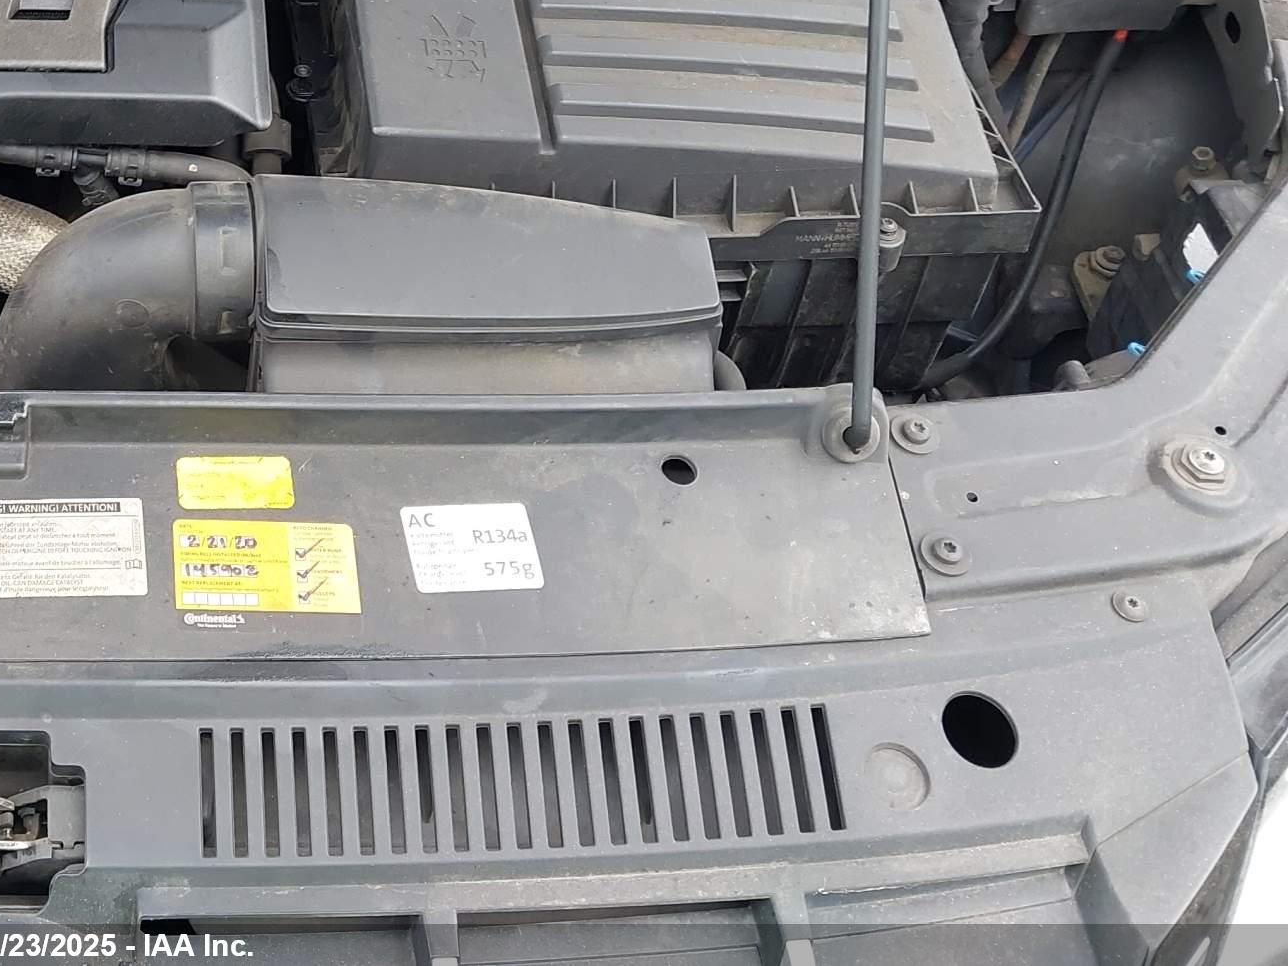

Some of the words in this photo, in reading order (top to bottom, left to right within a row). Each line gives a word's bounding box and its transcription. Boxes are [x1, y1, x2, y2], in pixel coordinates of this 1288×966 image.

[8, 504, 59, 514] WARNING!
[61, 503, 118, 513] ATTENTION!
[408, 512, 436, 528] AC
[472, 529, 528, 544] R134a
[484, 561, 535, 579] 575g
[183, 612, 237, 625] Continental
